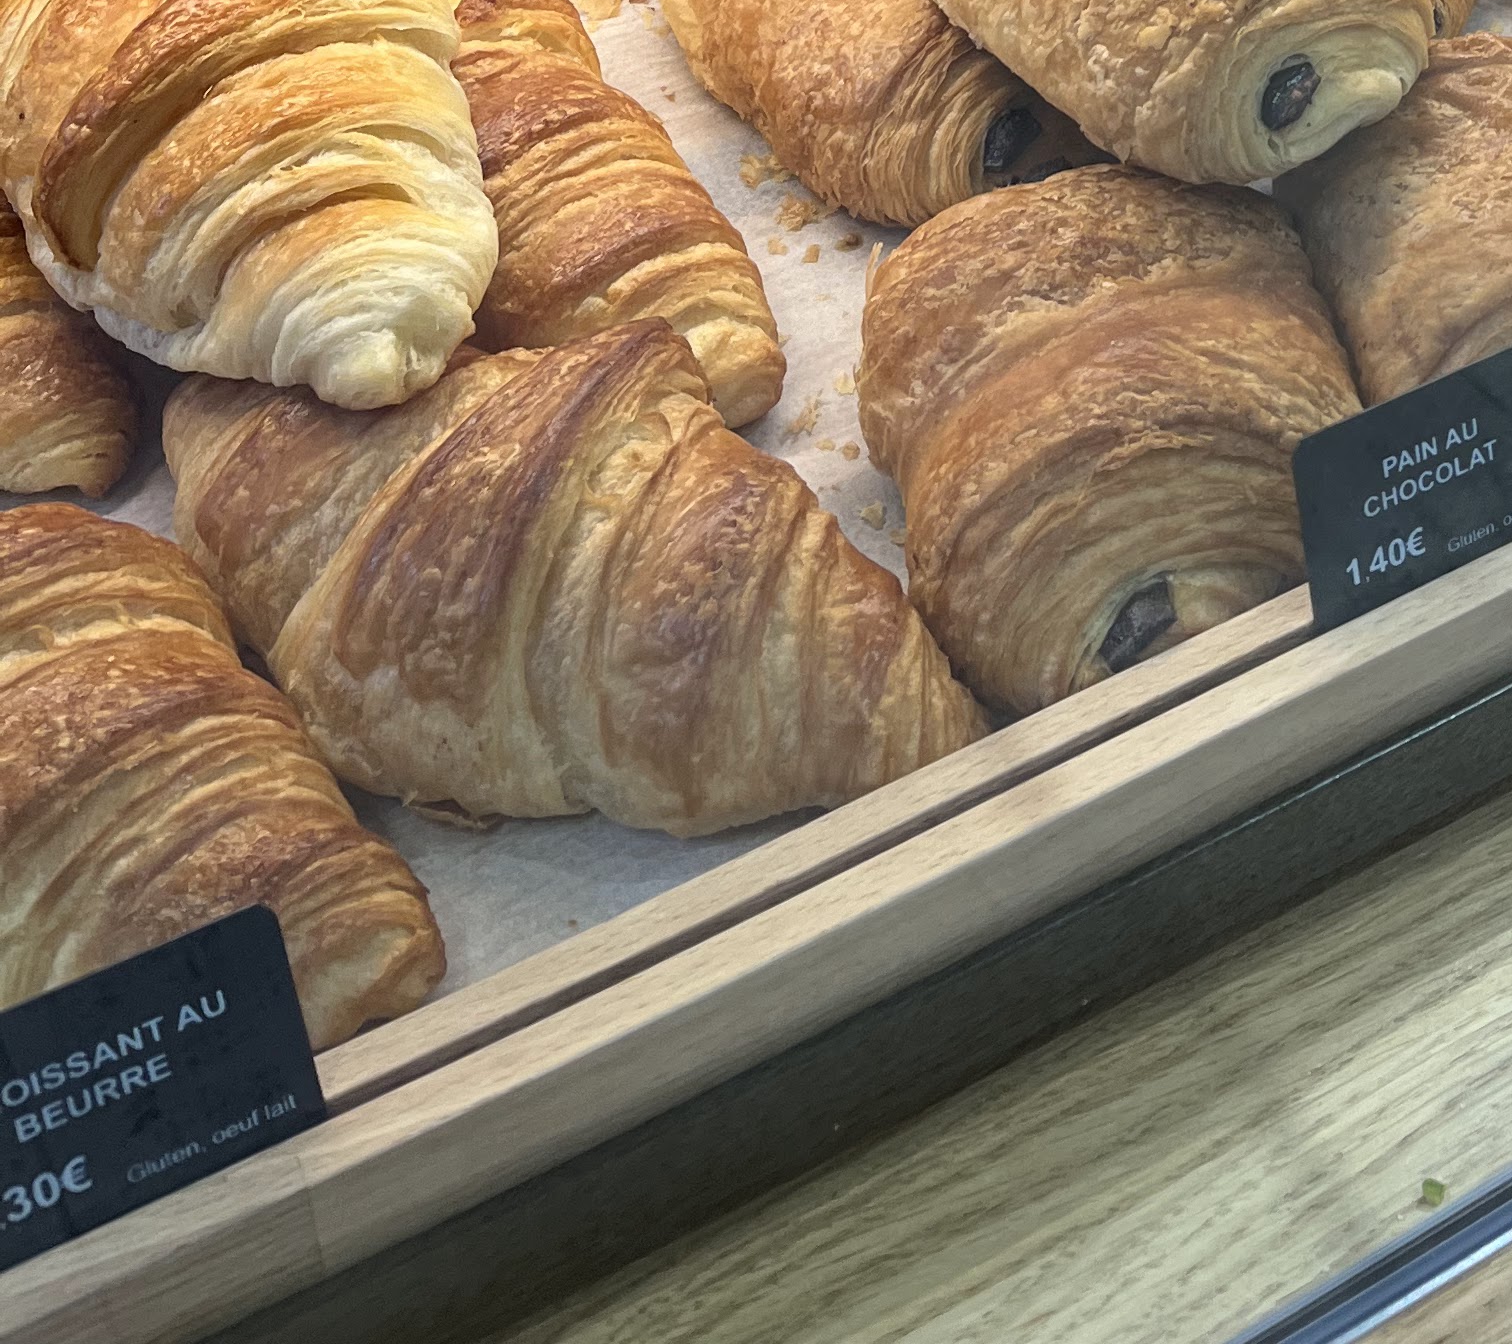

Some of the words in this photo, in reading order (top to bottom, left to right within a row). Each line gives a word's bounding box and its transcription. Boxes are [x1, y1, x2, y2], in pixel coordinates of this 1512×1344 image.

[1363, 439, 1497, 517] CHOCOLAT
[1382, 437, 1438, 479] PAIN
[1445, 418, 1478, 450] AU
[1346, 526, 1426, 586] 1,40€
[0, 1016, 164, 1107] OISSANT
[177, 989, 227, 1032] AU
[13, 1054, 172, 1144] BEURRE
[211, 1111, 260, 1145] oeuf
[264, 1093, 297, 1121] lait
[0, 1154, 93, 1230] ,30€
